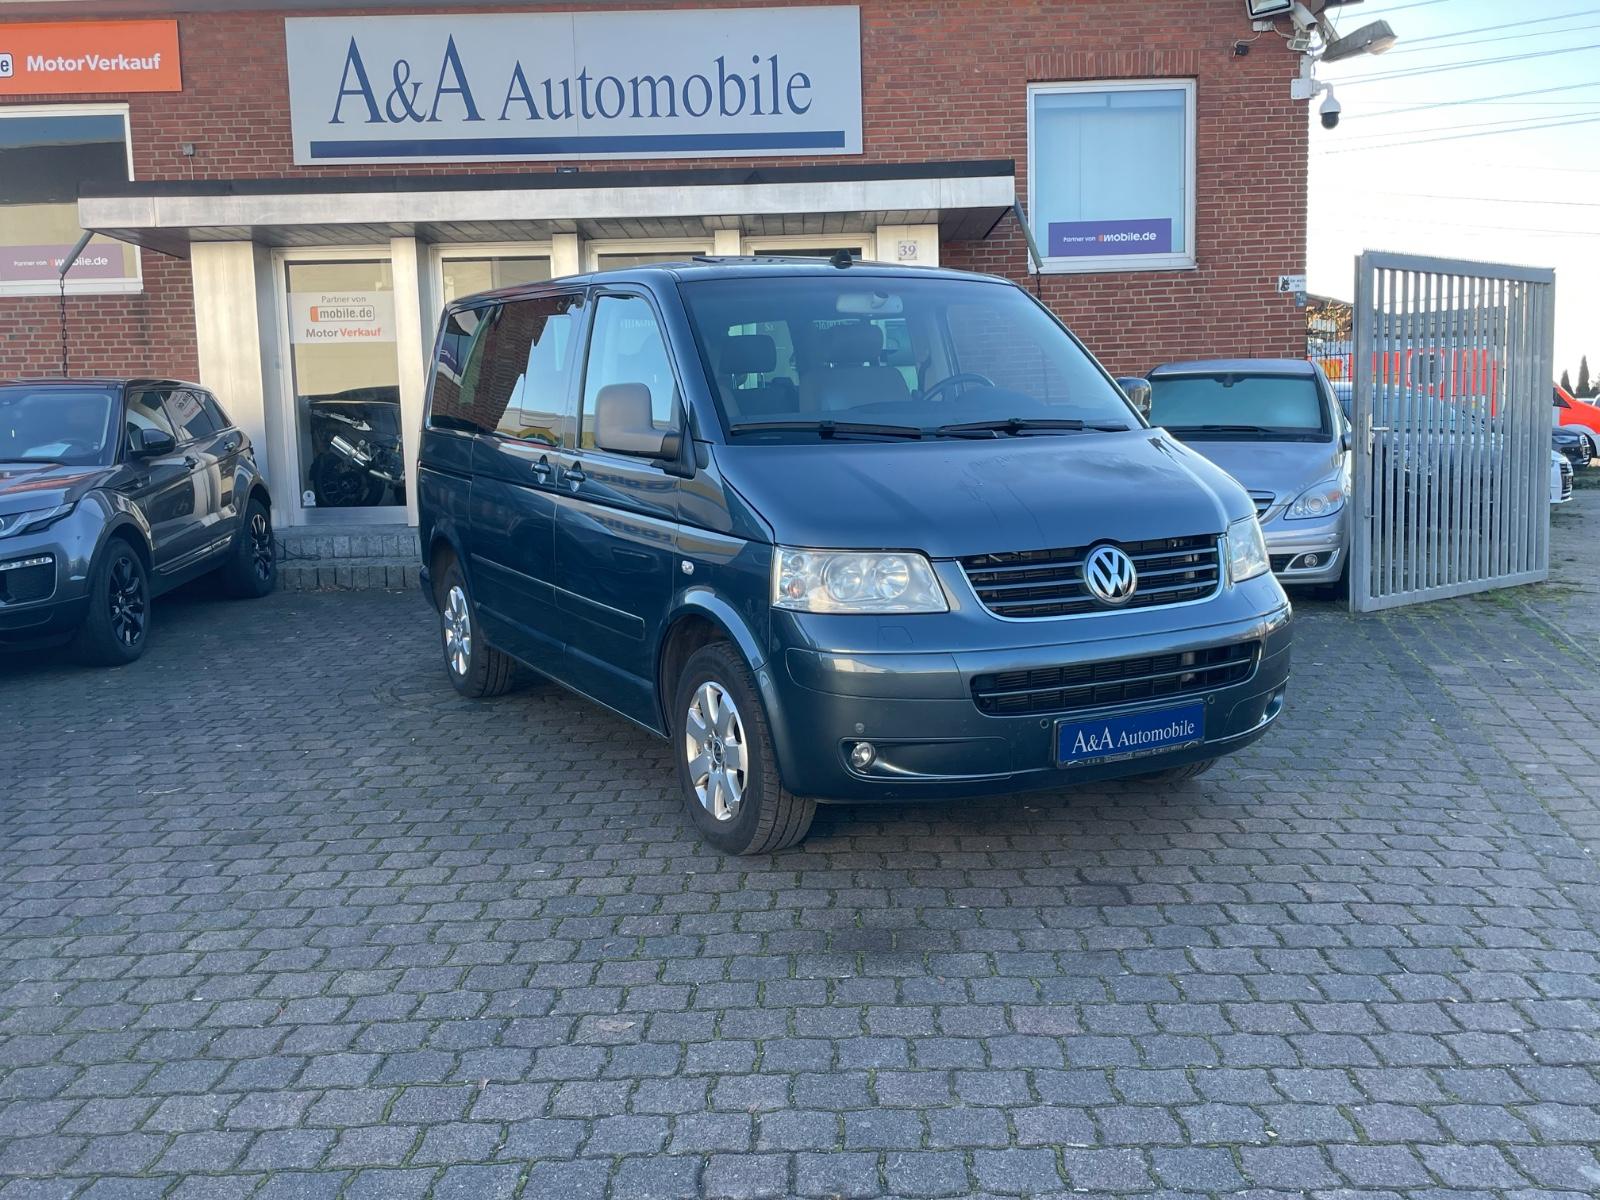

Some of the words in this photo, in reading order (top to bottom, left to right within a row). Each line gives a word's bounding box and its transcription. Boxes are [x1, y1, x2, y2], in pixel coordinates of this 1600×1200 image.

[328, 33, 485, 124] A&A
[498, 54, 813, 121] Automobile
[1103, 231, 1157, 242] mobile.de
[900, 245, 917, 257] 39
[321, 295, 350, 304] Partner
[319, 307, 373, 319] mobile.de
[1071, 726, 1115, 754] A&A
[1117, 720, 1196, 748] Automobile
